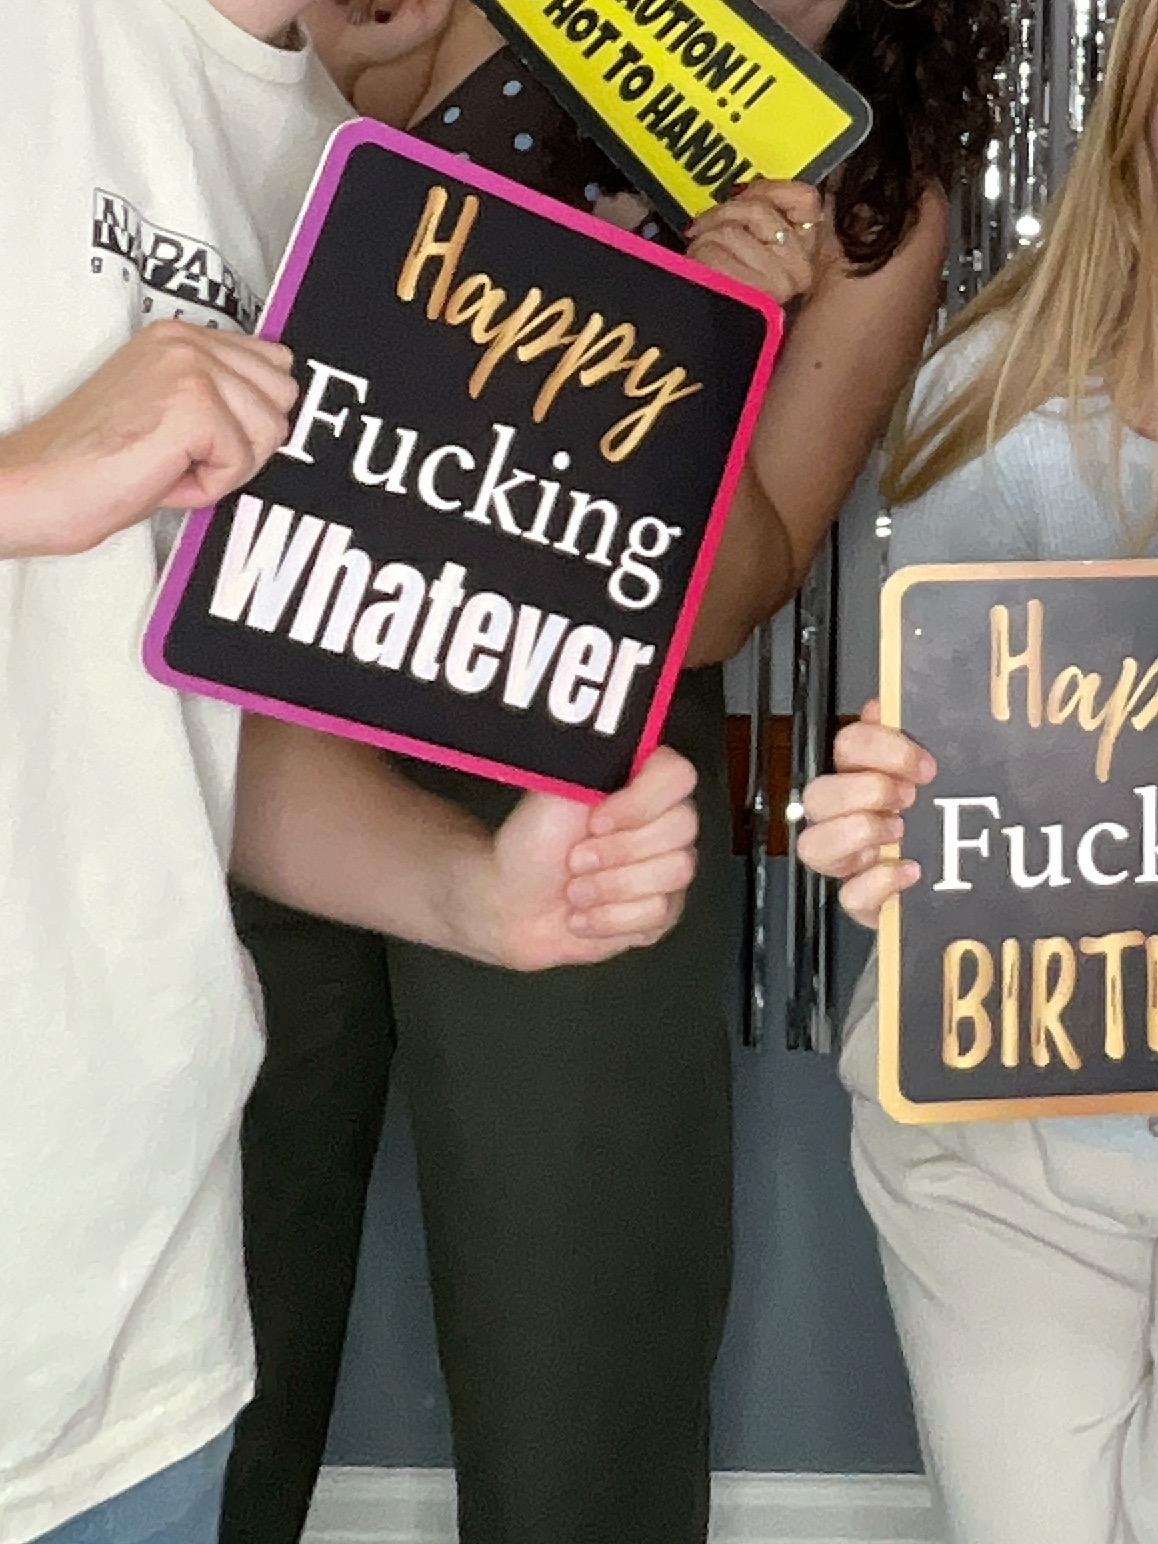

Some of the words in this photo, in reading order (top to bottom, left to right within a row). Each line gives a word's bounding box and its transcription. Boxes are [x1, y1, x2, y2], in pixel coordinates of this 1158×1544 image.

[602, 41, 655, 101] TO
[636, 83, 763, 203] HANDL
[396, 185, 703, 463] Happy
[276, 358, 682, 611] Fucking
[208, 493, 656, 736] Whatever
